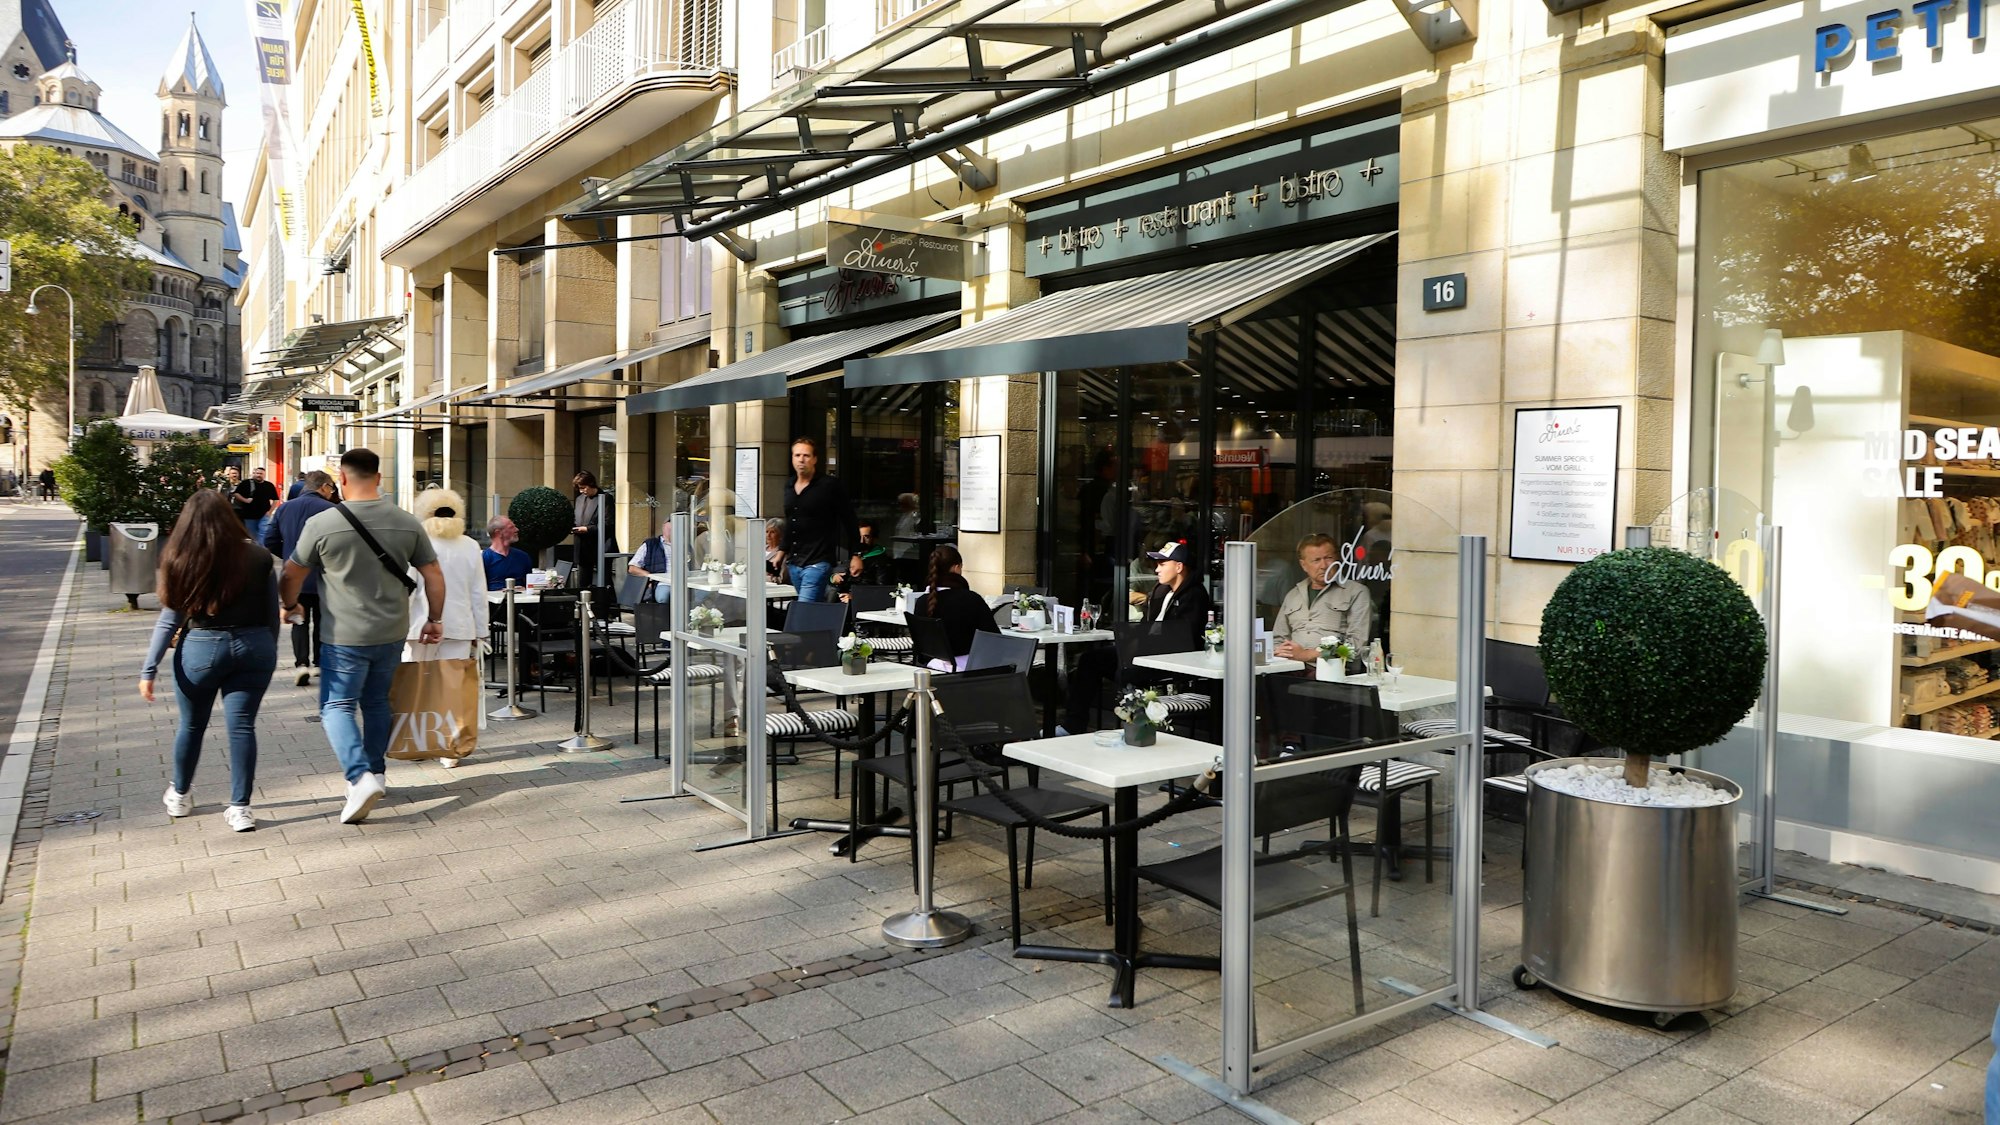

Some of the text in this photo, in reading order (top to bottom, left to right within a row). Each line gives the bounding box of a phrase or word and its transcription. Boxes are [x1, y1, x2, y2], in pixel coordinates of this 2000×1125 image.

[1815, 0, 1984, 72] PETI
[1059, 226, 1102, 251] bistro
[1137, 191, 1236, 233] restaurant
[1280, 169, 1341, 203] bistro
[844, 228, 919, 274] Diner's
[890, 233, 959, 253] Bistro Restaurant
[1432, 280, 1455, 303] 16
[1864, 427, 2000, 461] MID SEA
[1862, 466, 1943, 498] SALE
[1324, 525, 1400, 584] Diner's
[1557, 545, 1573, 554] NUR
[386, 709, 461, 753] ZARA
